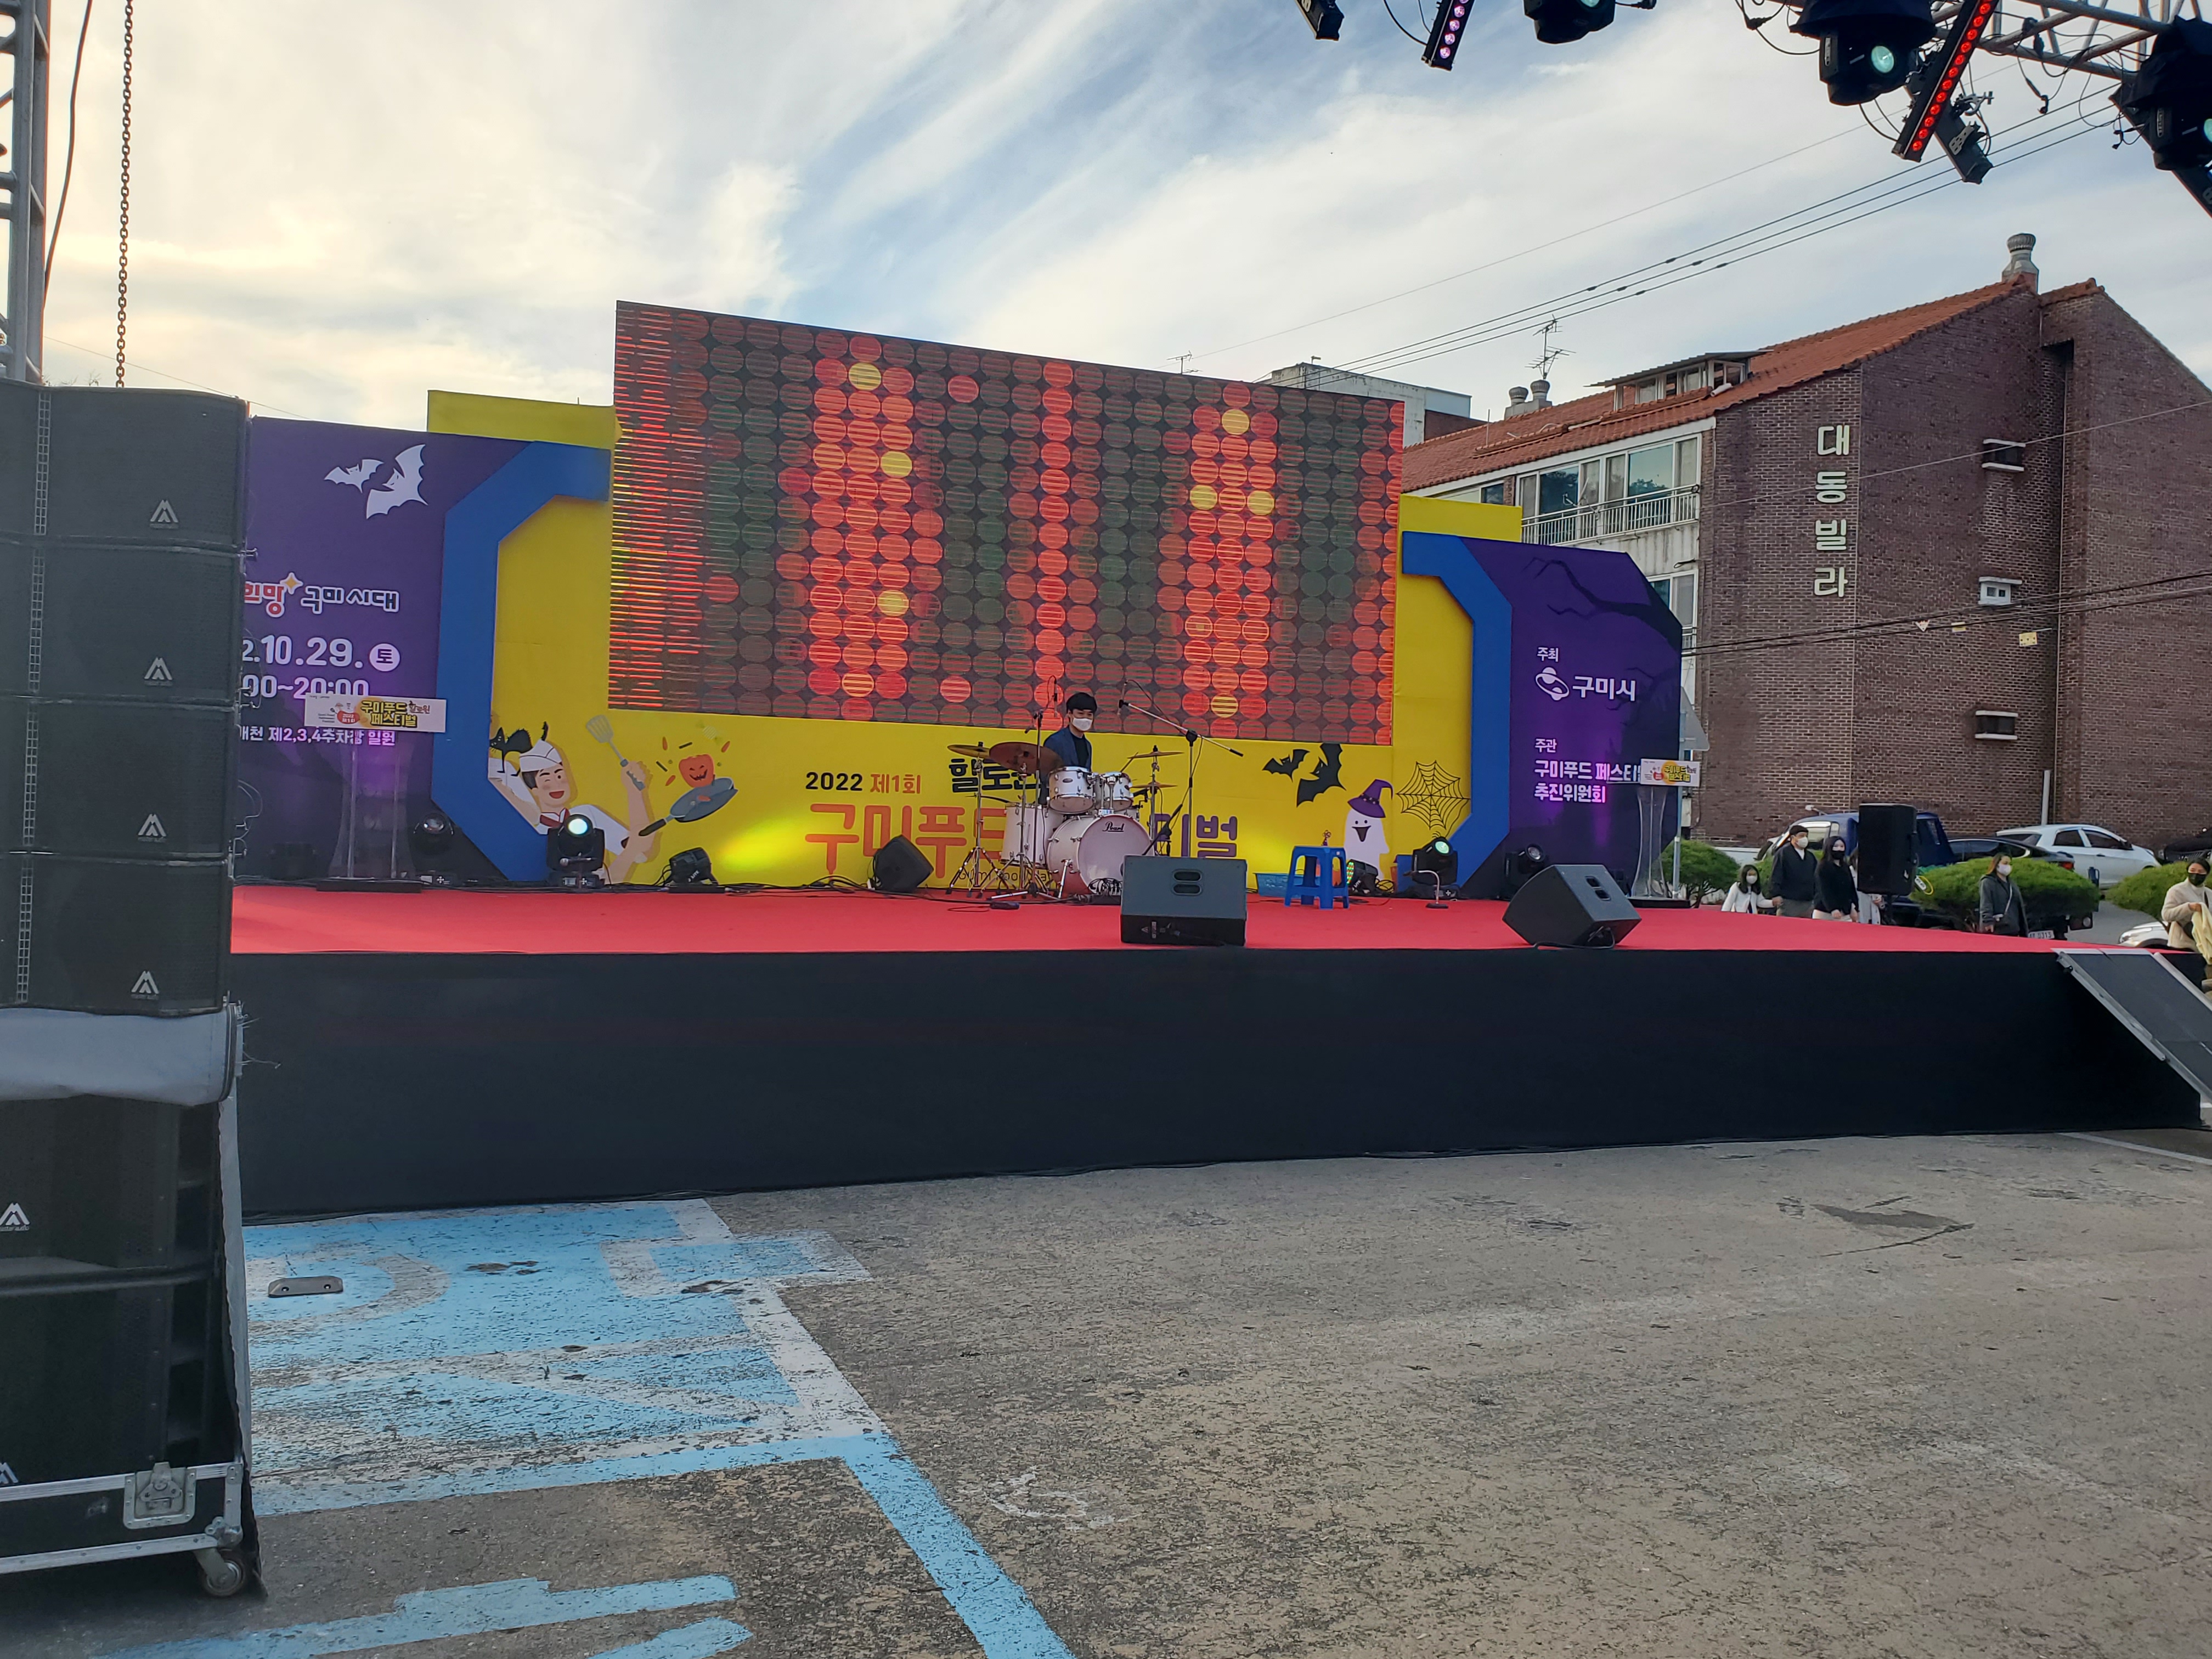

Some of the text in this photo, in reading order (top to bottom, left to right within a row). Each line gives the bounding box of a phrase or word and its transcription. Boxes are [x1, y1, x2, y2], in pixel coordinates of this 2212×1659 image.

[1814, 425, 1849, 597] 대동빌라
[1537, 646, 1559, 662] 주최
[1573, 676, 1635, 701] 구미시
[360, 700, 408, 714] 구미푸드
[370, 713, 418, 727] 페스티벌
[368, 731, 396, 746] 일원
[1534, 738, 1557, 753] 주관
[1534, 760, 1593, 780] 구미푸드
[806, 771, 922, 794] 2022 제1회
[1534, 783, 1606, 803] 추진위원회
